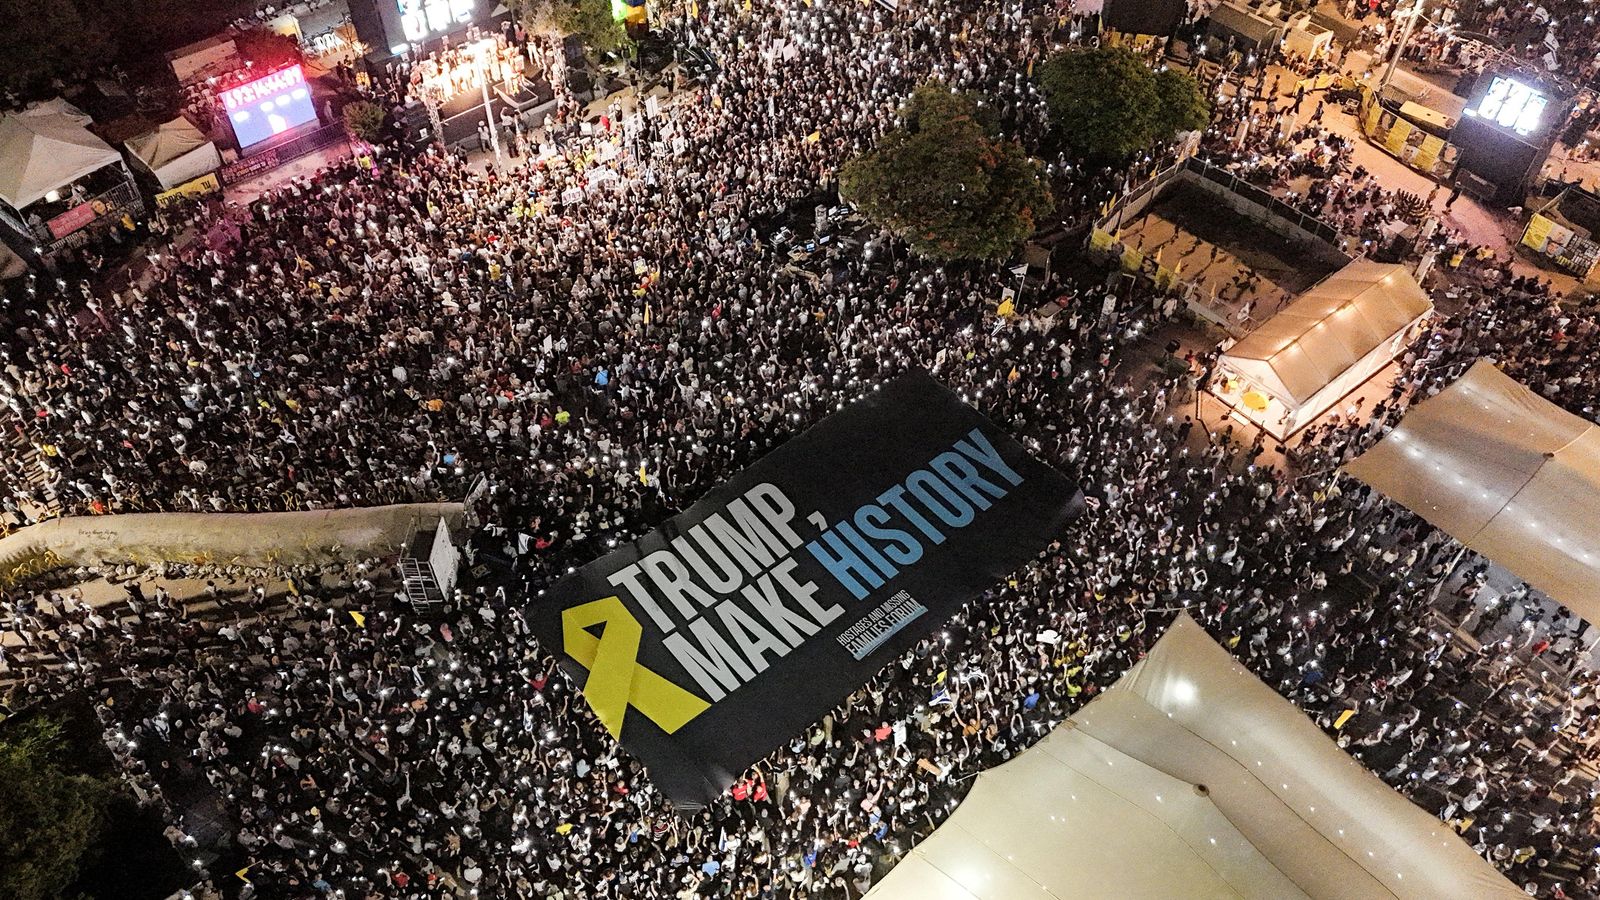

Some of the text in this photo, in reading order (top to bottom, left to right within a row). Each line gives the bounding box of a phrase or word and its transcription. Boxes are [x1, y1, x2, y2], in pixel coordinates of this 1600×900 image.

[607, 482, 826, 634] TRUMP,
[661, 427, 1024, 703] MAKE HISTORY
[836, 589, 911, 646] HOSTAGES AND MISSING
[845, 598, 923, 656] FAMILIES FORUM
